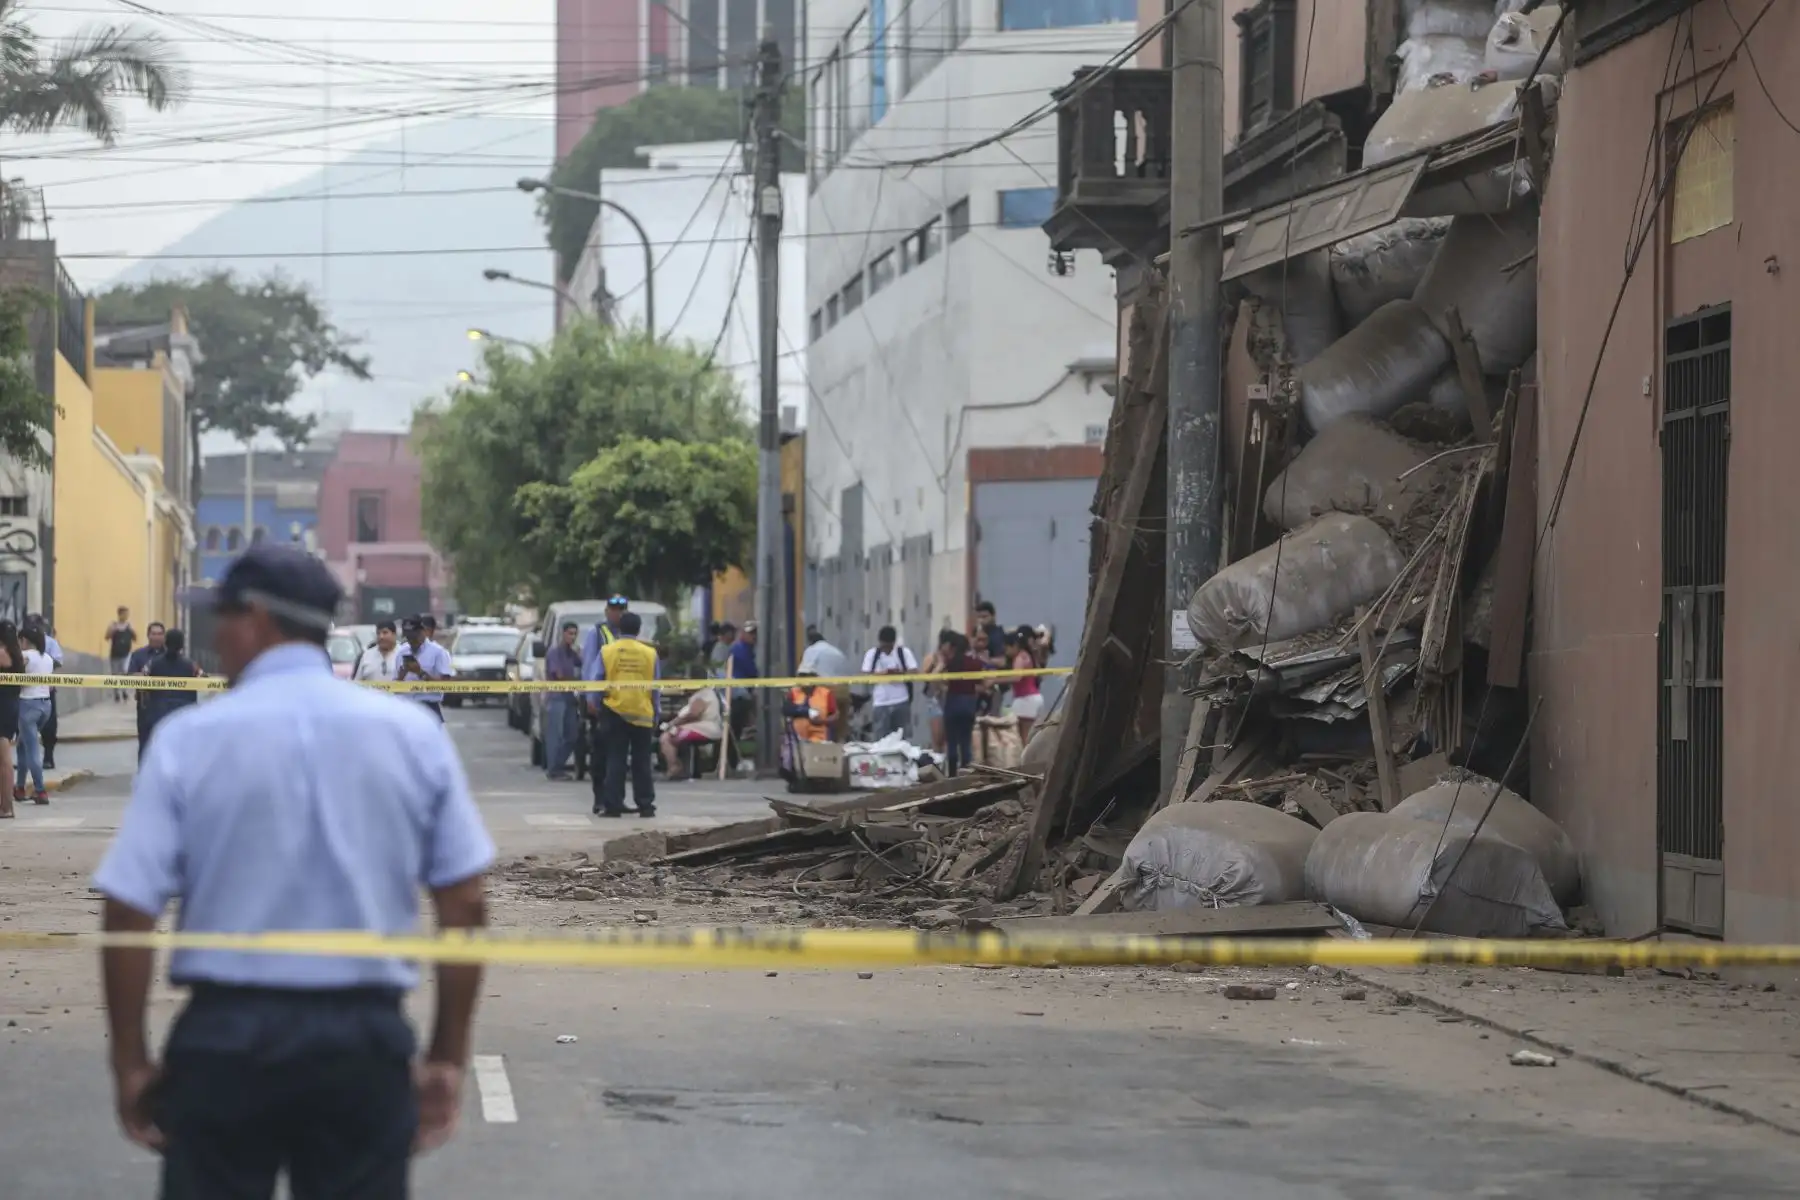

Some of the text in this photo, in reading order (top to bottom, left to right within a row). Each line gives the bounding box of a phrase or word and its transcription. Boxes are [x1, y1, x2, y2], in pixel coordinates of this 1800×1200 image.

[15, 674, 61, 684] RESTRINGIDA
[63, 676, 84, 685] ZONA
[103, 678, 187, 688] ZONA RESTRINGIDA PNP
